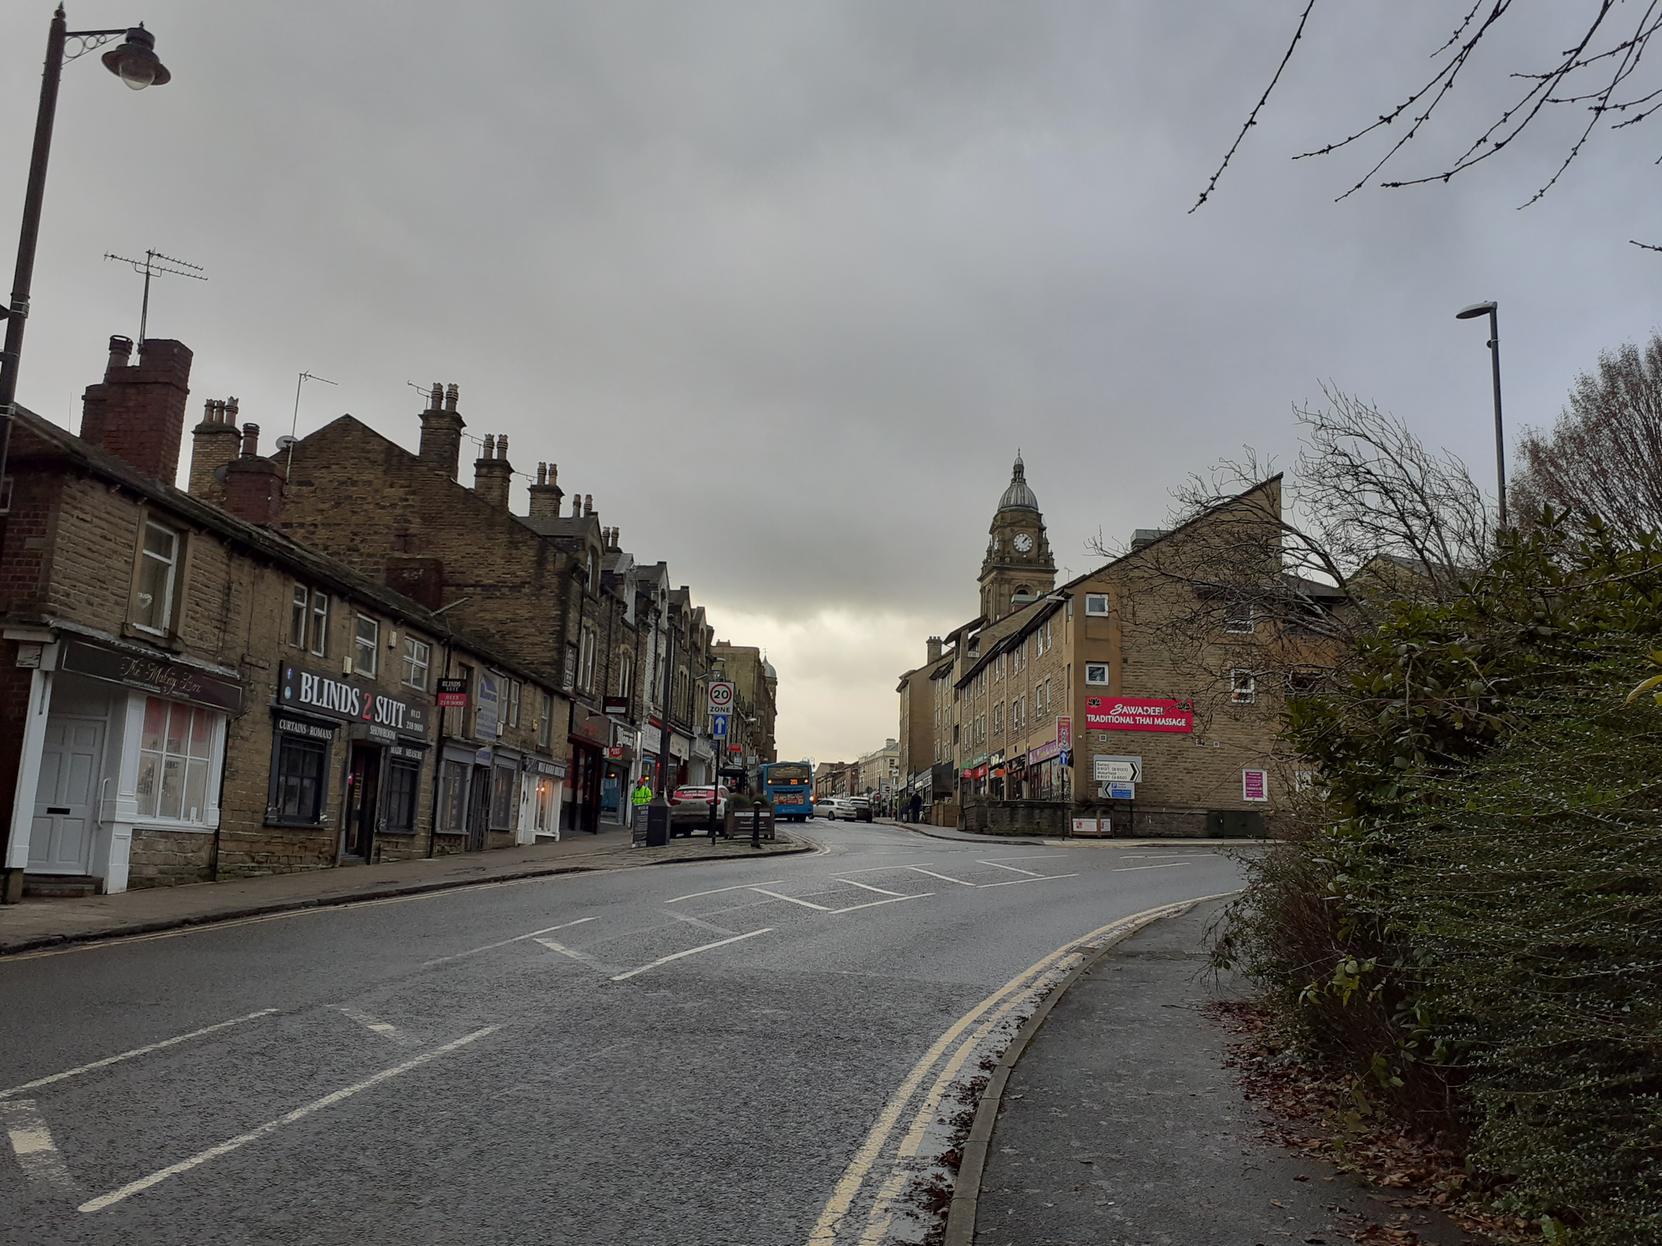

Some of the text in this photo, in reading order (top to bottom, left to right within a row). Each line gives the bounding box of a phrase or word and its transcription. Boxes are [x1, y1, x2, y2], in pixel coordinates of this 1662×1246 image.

[299, 672, 406, 729] BLINDS 2 SUIT
[713, 689, 729, 699] 20
[1086, 714, 1187, 727] TRADITIONAL THAI MASSAGE
[279, 719, 333, 740] CURTAINS ROMANS
